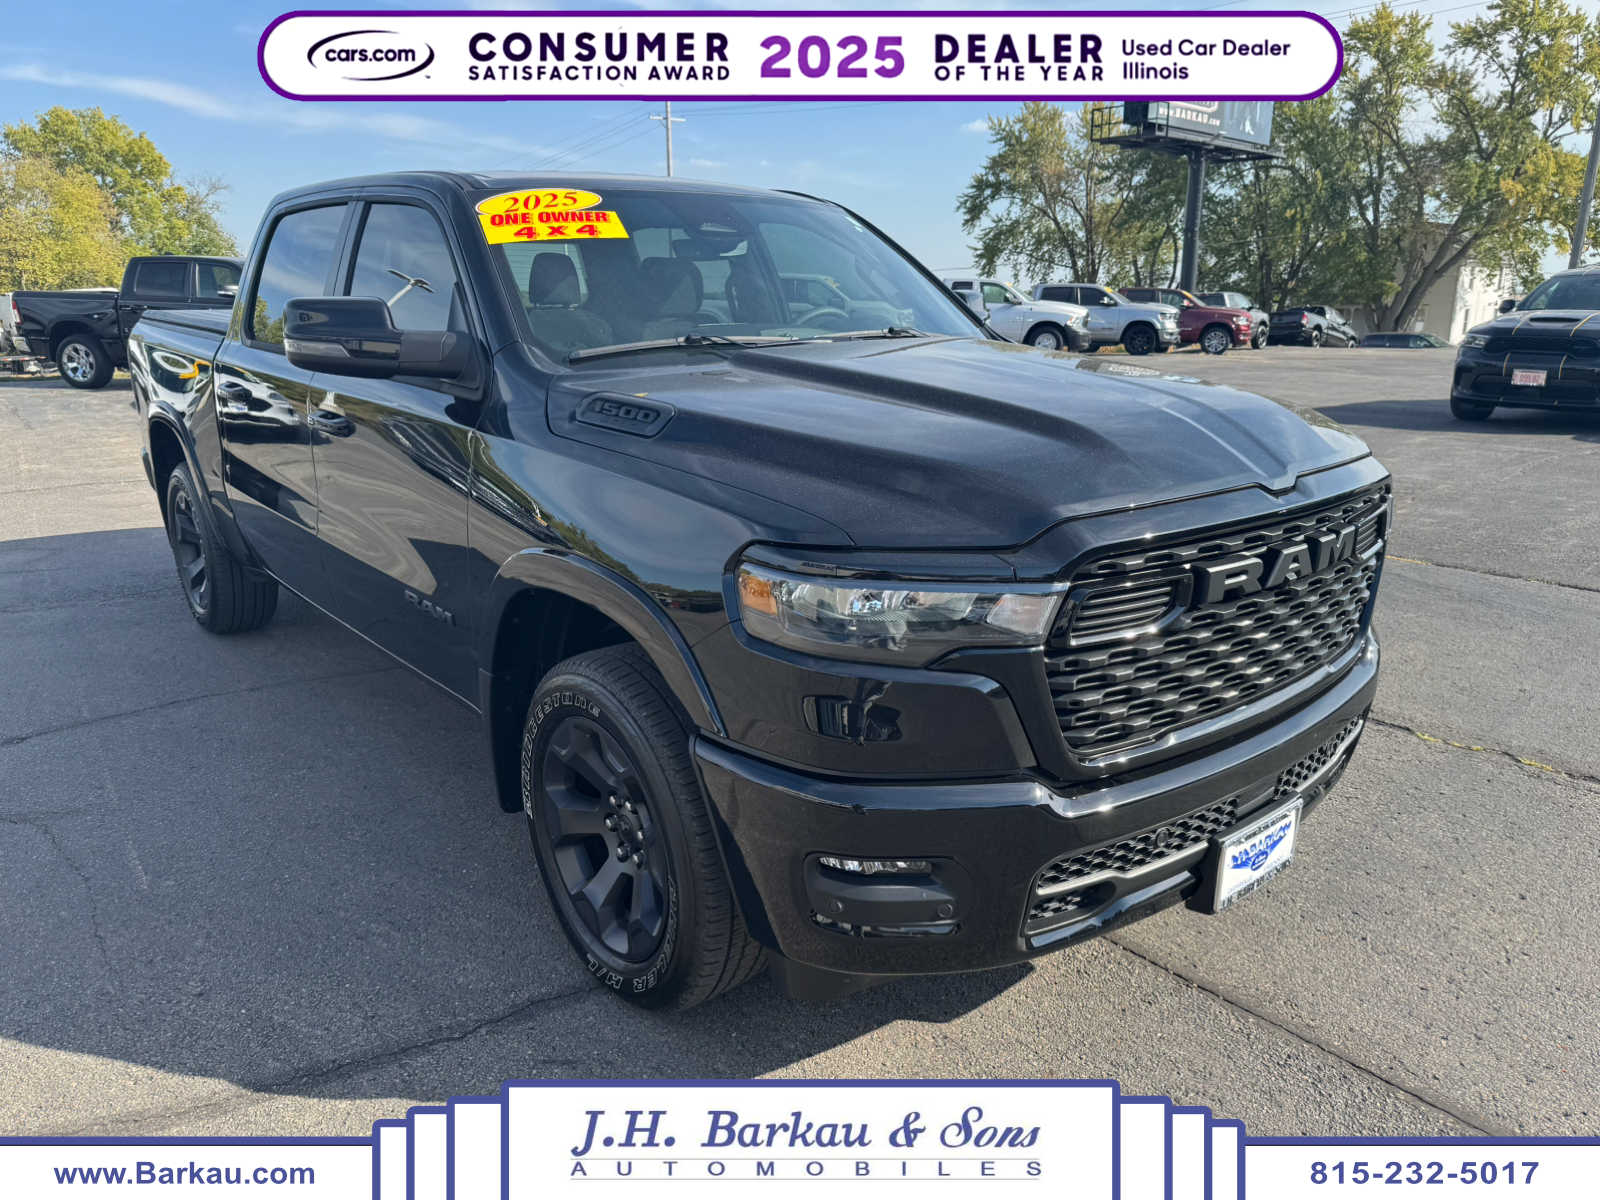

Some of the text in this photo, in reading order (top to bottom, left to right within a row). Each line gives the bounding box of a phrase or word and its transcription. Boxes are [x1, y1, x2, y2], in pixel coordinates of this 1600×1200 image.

[504, 192, 577, 213] 2025
[490, 211, 608, 226] ONE OWNER
[1205, 525, 1355, 603] RAM
[404, 590, 454, 625] RAM
